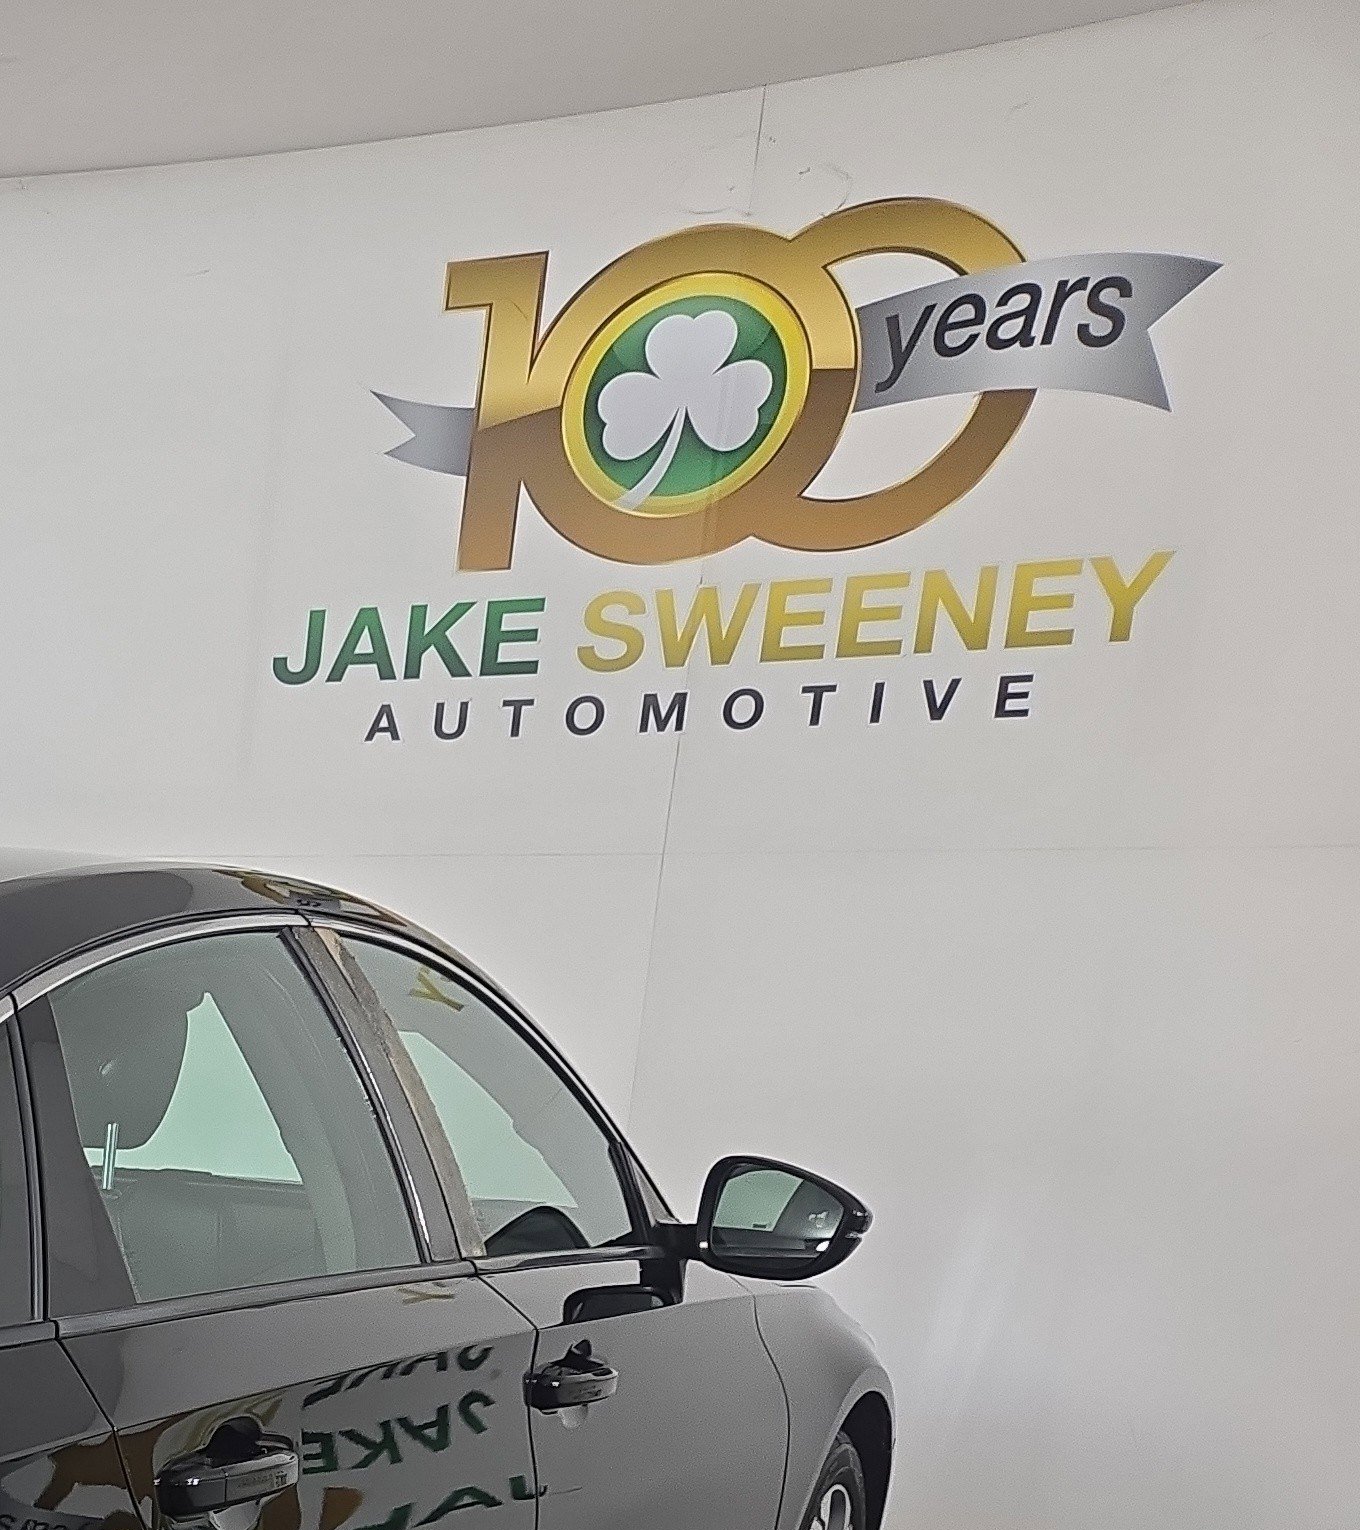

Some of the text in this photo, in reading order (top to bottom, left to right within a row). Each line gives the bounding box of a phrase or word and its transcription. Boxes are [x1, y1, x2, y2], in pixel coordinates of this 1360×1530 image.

[874, 270, 1133, 393] years
[271, 550, 1176, 686] JAKE SWEENEY
[366, 674, 1035, 743] AUTOMOTIVE
